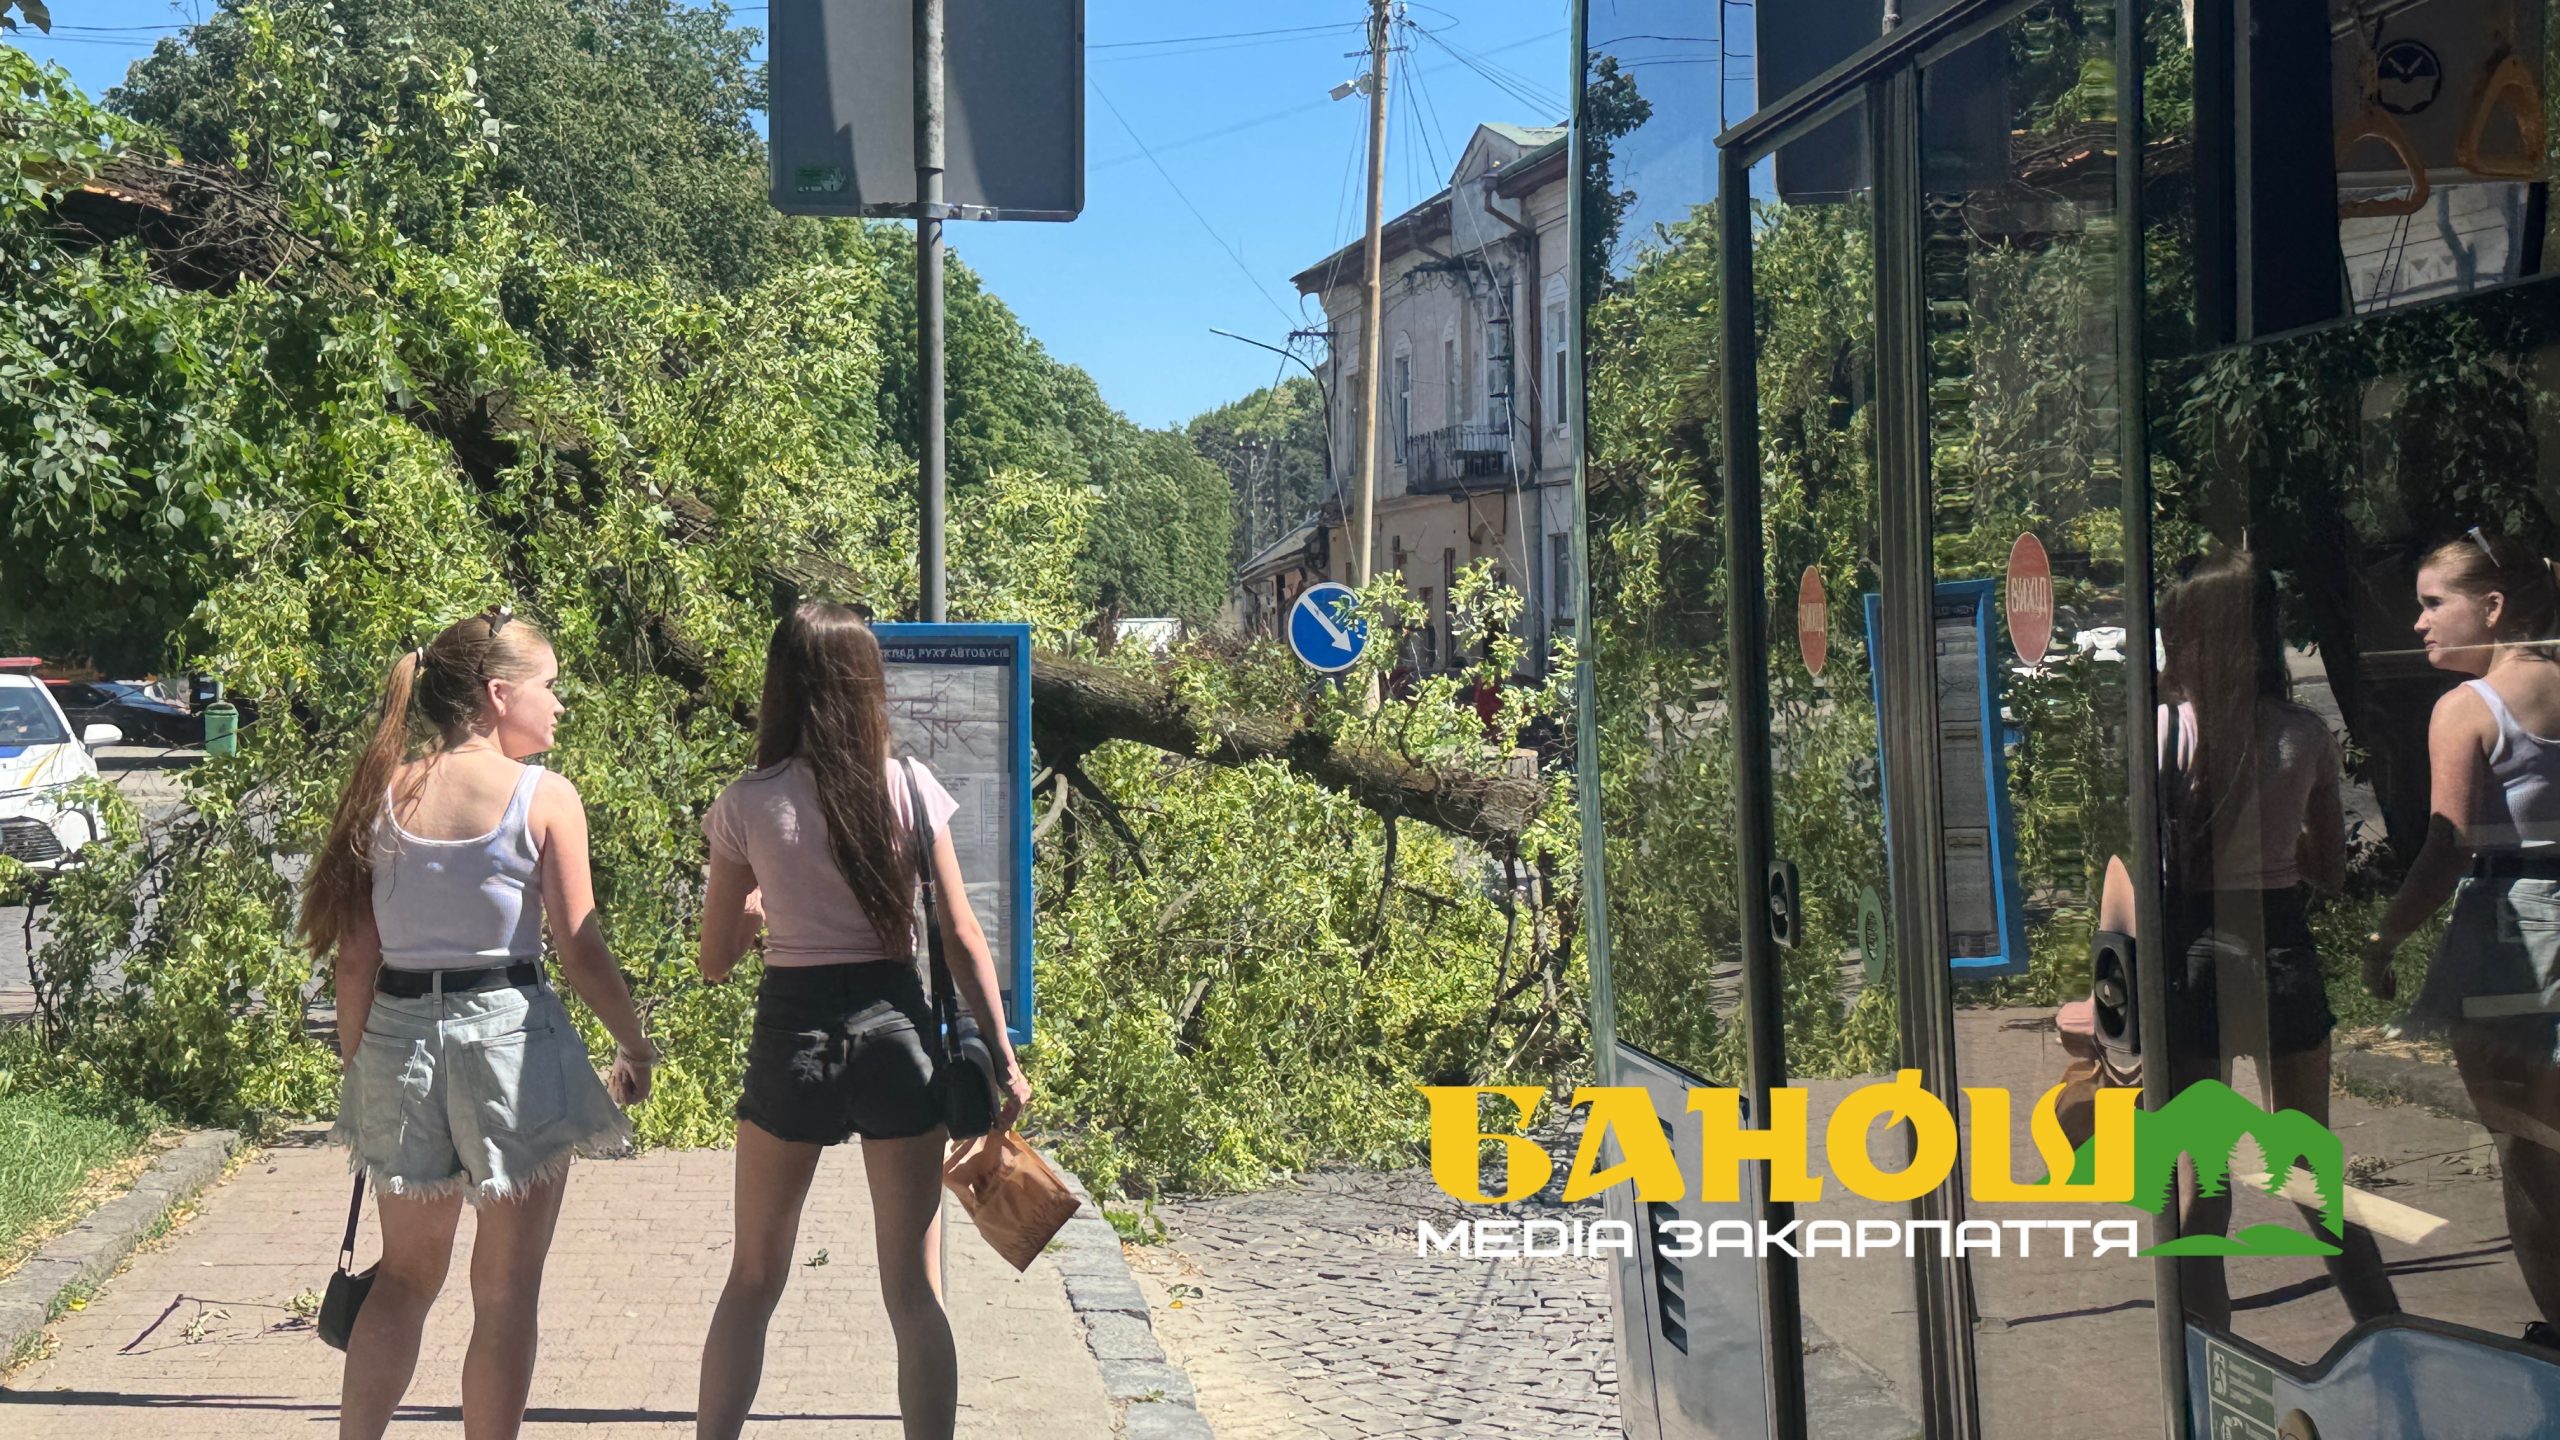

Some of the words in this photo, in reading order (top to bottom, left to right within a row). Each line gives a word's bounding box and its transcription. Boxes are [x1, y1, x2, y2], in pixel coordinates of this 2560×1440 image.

[880, 648, 916, 660] КЛАД
[918, 648, 947, 658] РУХУ
[950, 647, 1010, 658] АВТОБУСІВ
